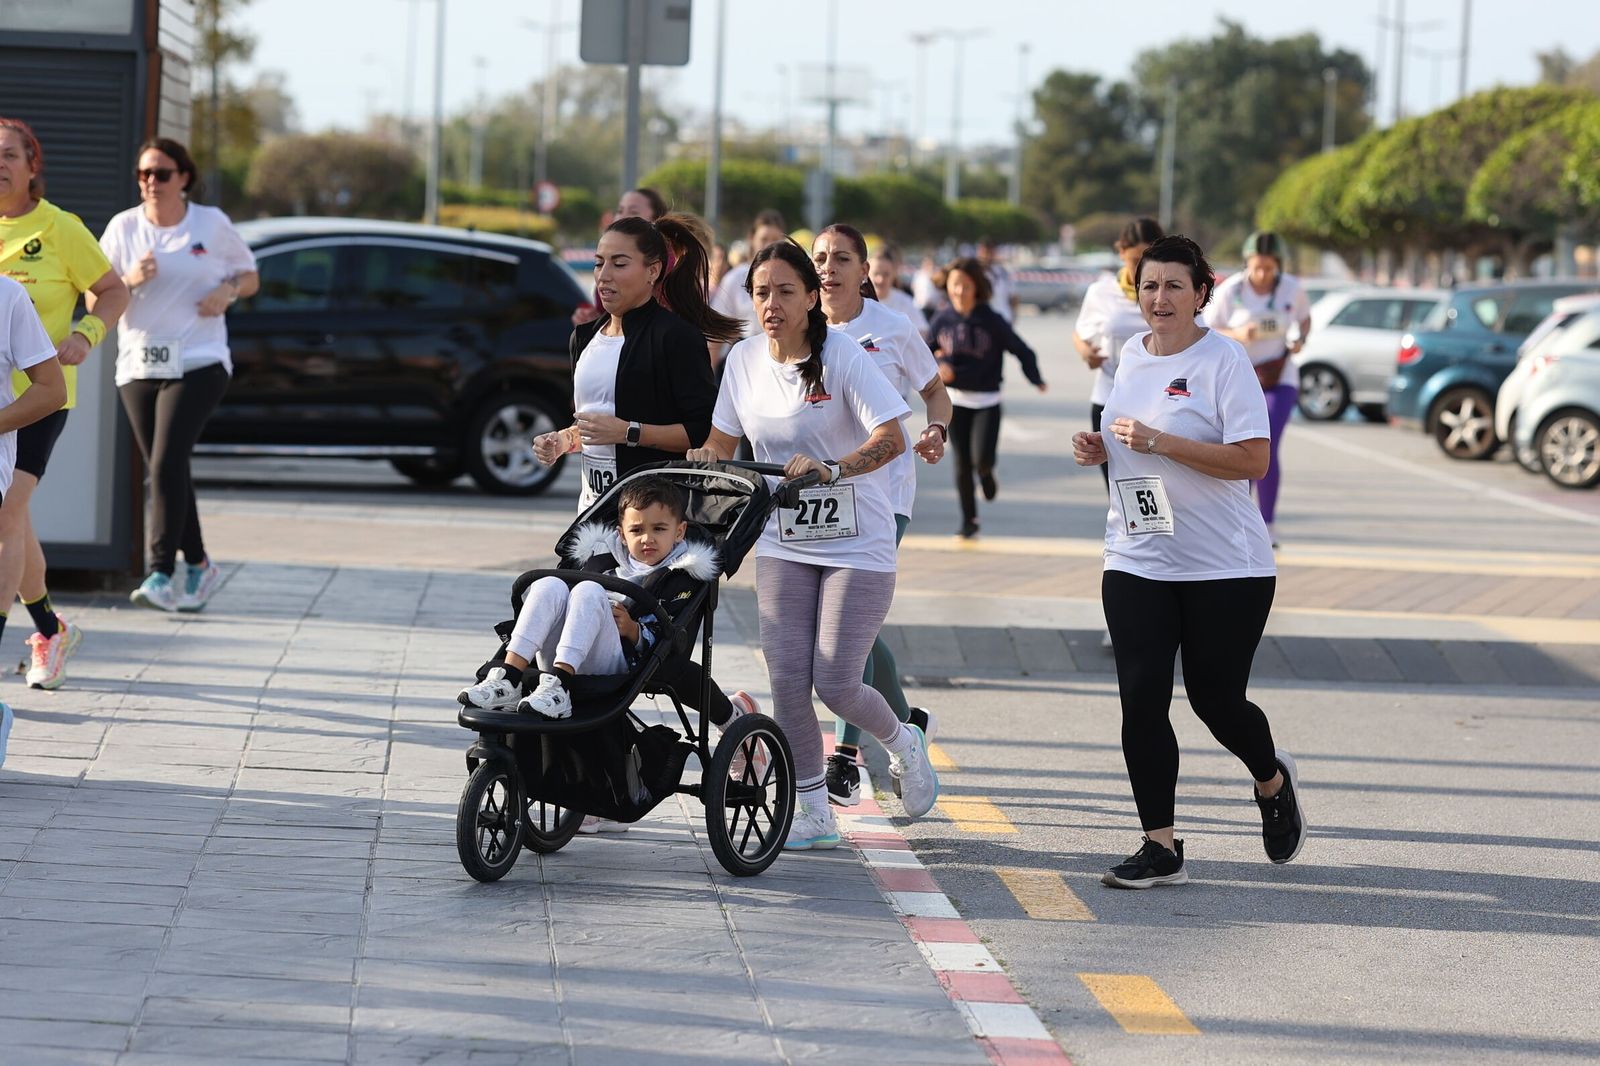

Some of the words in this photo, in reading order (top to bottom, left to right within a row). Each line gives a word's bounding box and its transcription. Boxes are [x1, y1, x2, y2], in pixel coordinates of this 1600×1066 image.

[142, 346, 169, 363] 390
[793, 497, 840, 525] 272
[1135, 489, 1159, 516] 53
